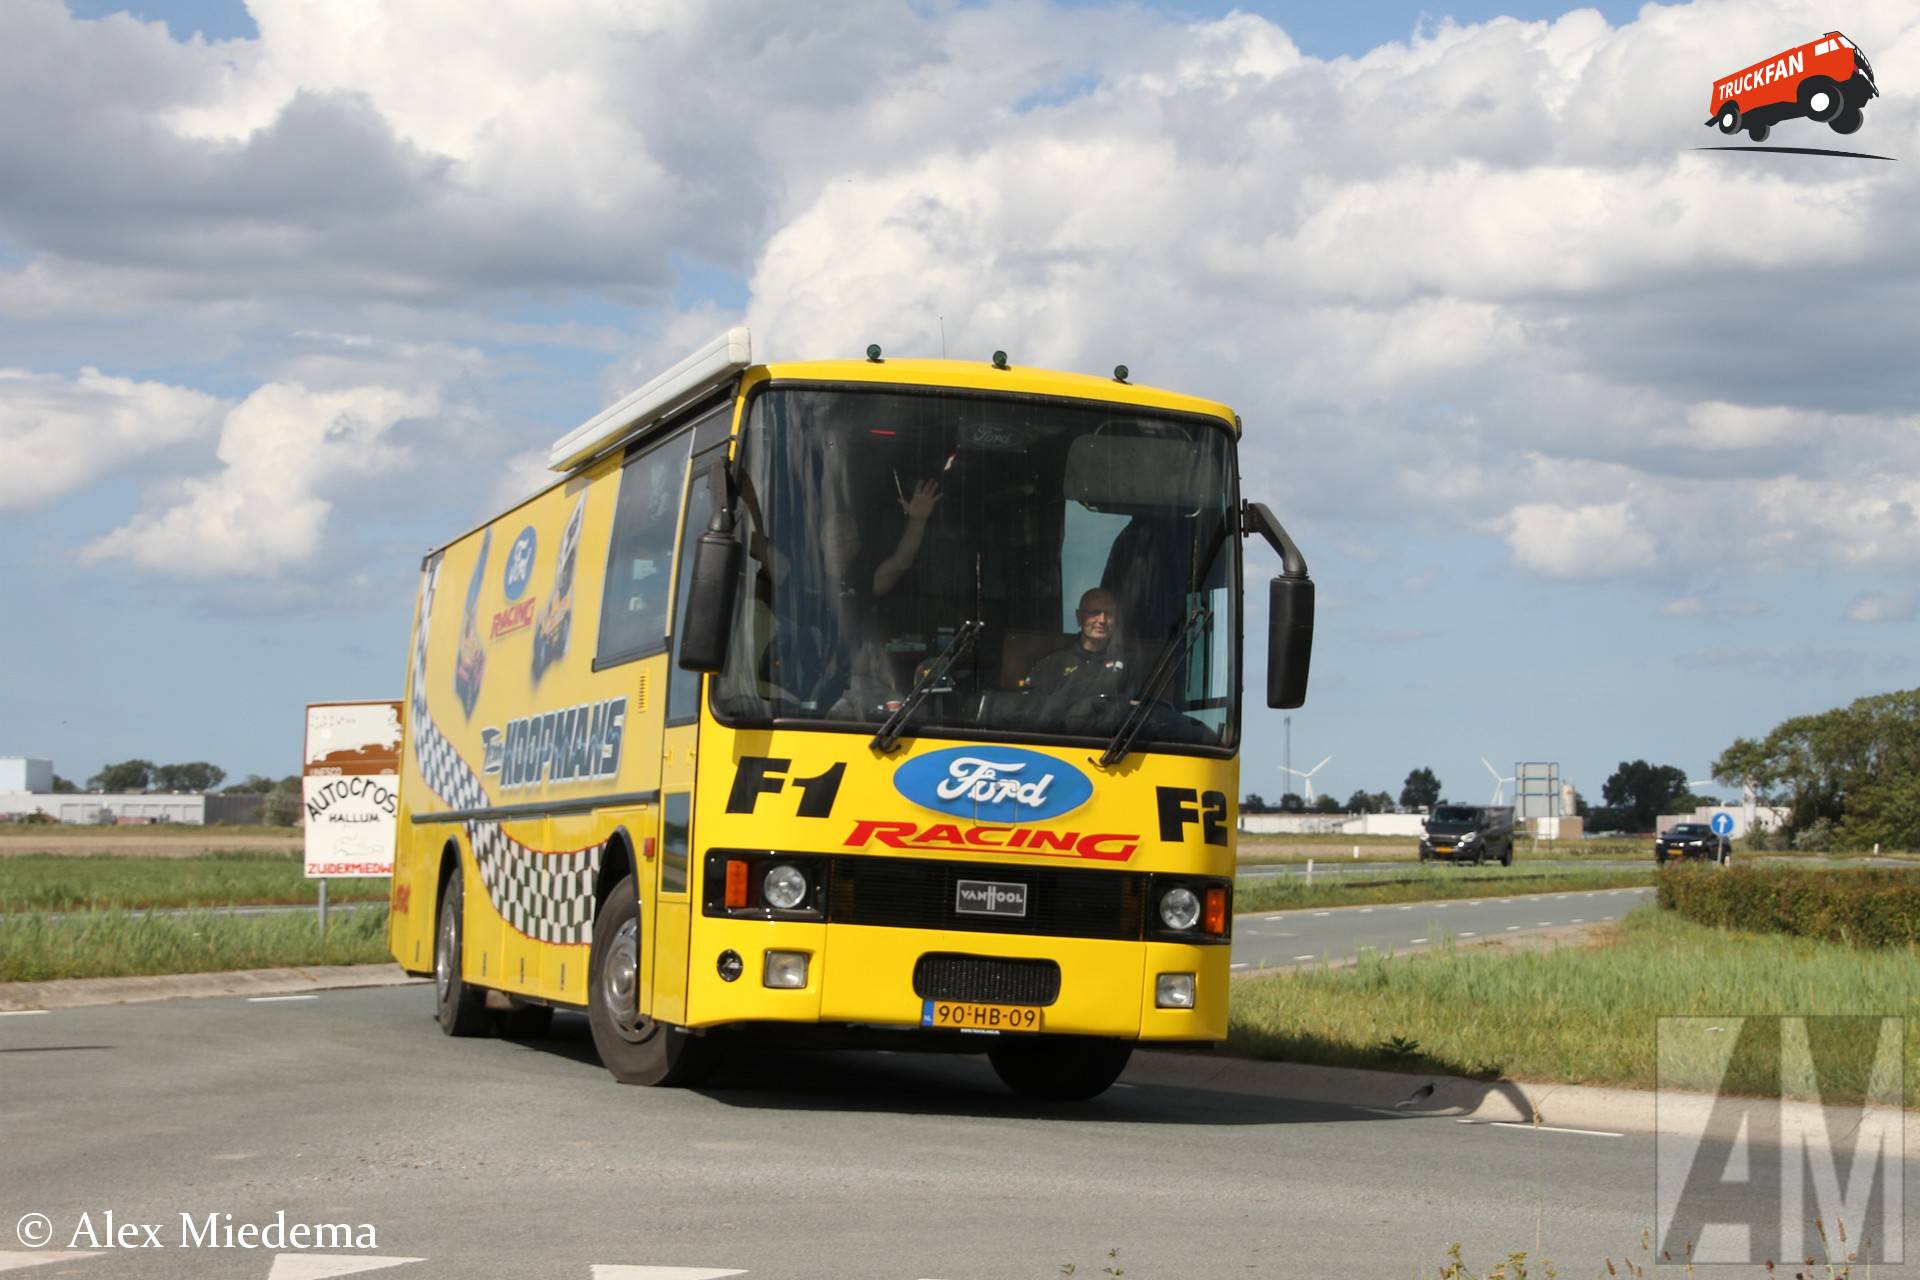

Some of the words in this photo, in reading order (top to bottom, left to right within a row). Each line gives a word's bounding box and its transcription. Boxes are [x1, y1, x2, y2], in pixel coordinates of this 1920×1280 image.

[500, 697, 628, 788] KOOPMANS
[725, 756, 847, 818] F1
[936, 757, 1054, 807] Ford
[329, 813, 380, 823] HALLUM
[843, 820, 1140, 862] RACING
[1156, 786, 1228, 847] F2
[938, 1005, 1036, 1027] 90-HB-09
